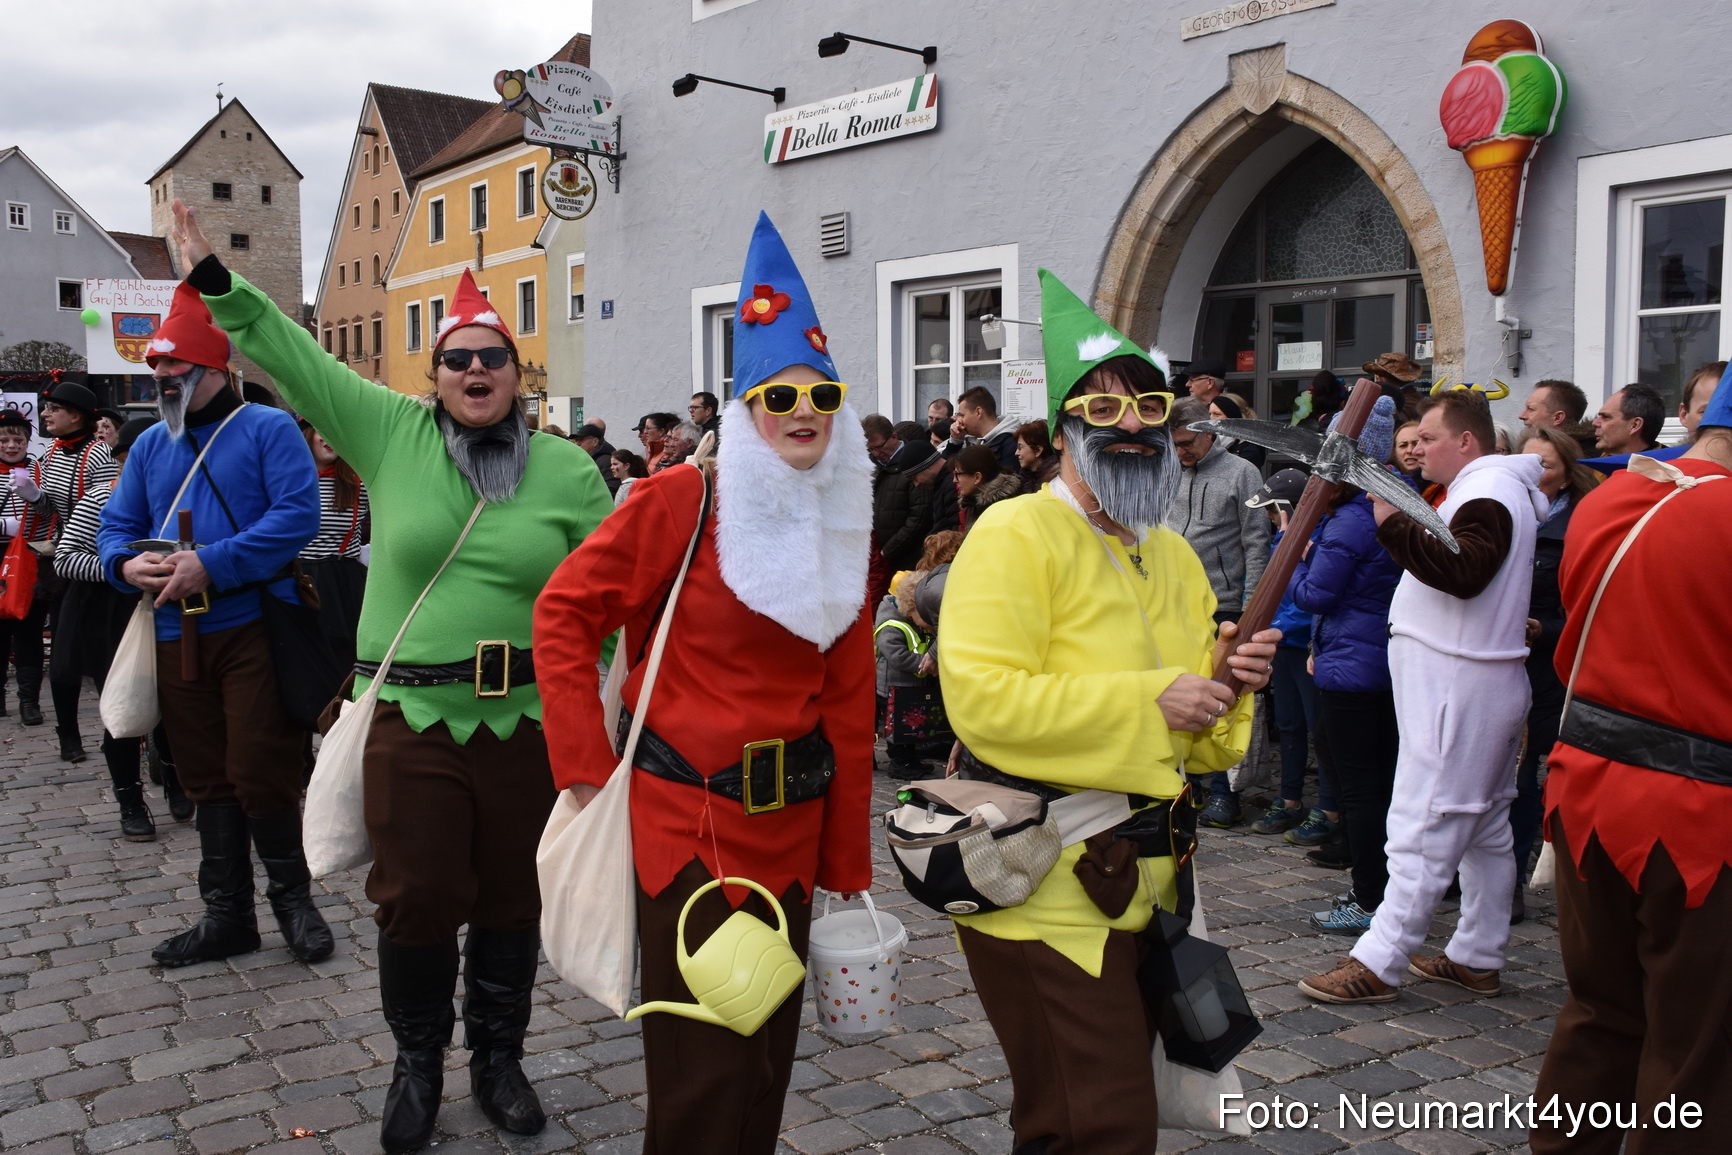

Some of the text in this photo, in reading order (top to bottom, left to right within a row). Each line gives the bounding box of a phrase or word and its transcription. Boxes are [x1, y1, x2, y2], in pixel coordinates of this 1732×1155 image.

[546, 64, 592, 83] Pizzeria
[557, 83, 582, 97] Café
[544, 96, 593, 115] Eisdiele
[797, 105, 830, 121] Pizzeria
[838, 98, 859, 112] Café
[866, 87, 902, 105] Eisdiele
[529, 128, 567, 142] Roma
[553, 125, 587, 137] Bella
[790, 113, 903, 152] Bella Roma
[556, 203, 582, 213] BERCHING
[1283, 357, 1294, 366] bis
[1007, 369, 1033, 378] Bella
[1016, 377, 1044, 385] Roma
